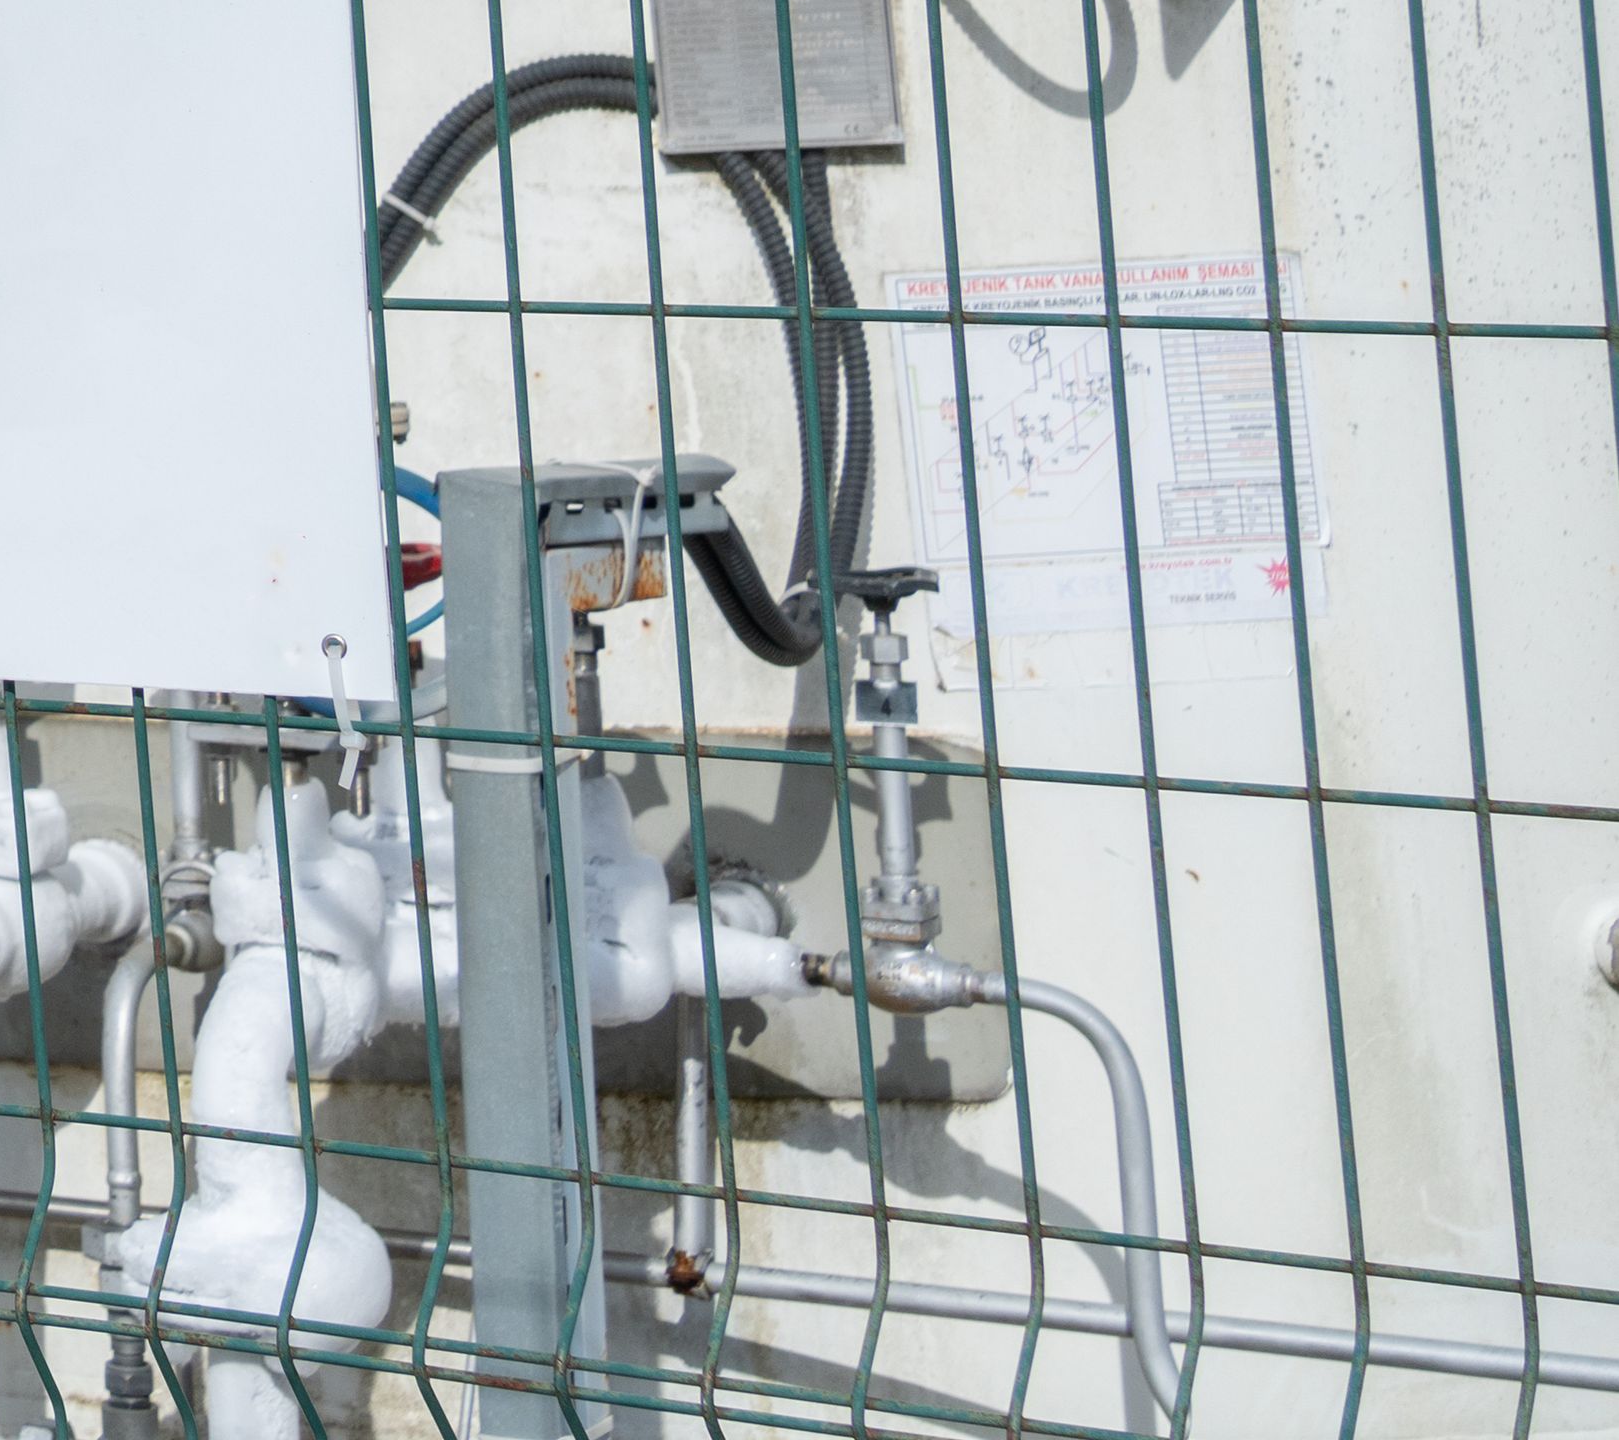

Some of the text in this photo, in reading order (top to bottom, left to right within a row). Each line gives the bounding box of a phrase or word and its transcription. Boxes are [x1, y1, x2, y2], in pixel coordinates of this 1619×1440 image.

[907, 277, 1006, 296] KREYJENİK
[1015, 275, 1056, 292] TANK
[1117, 265, 1189, 284] ULLANIM
